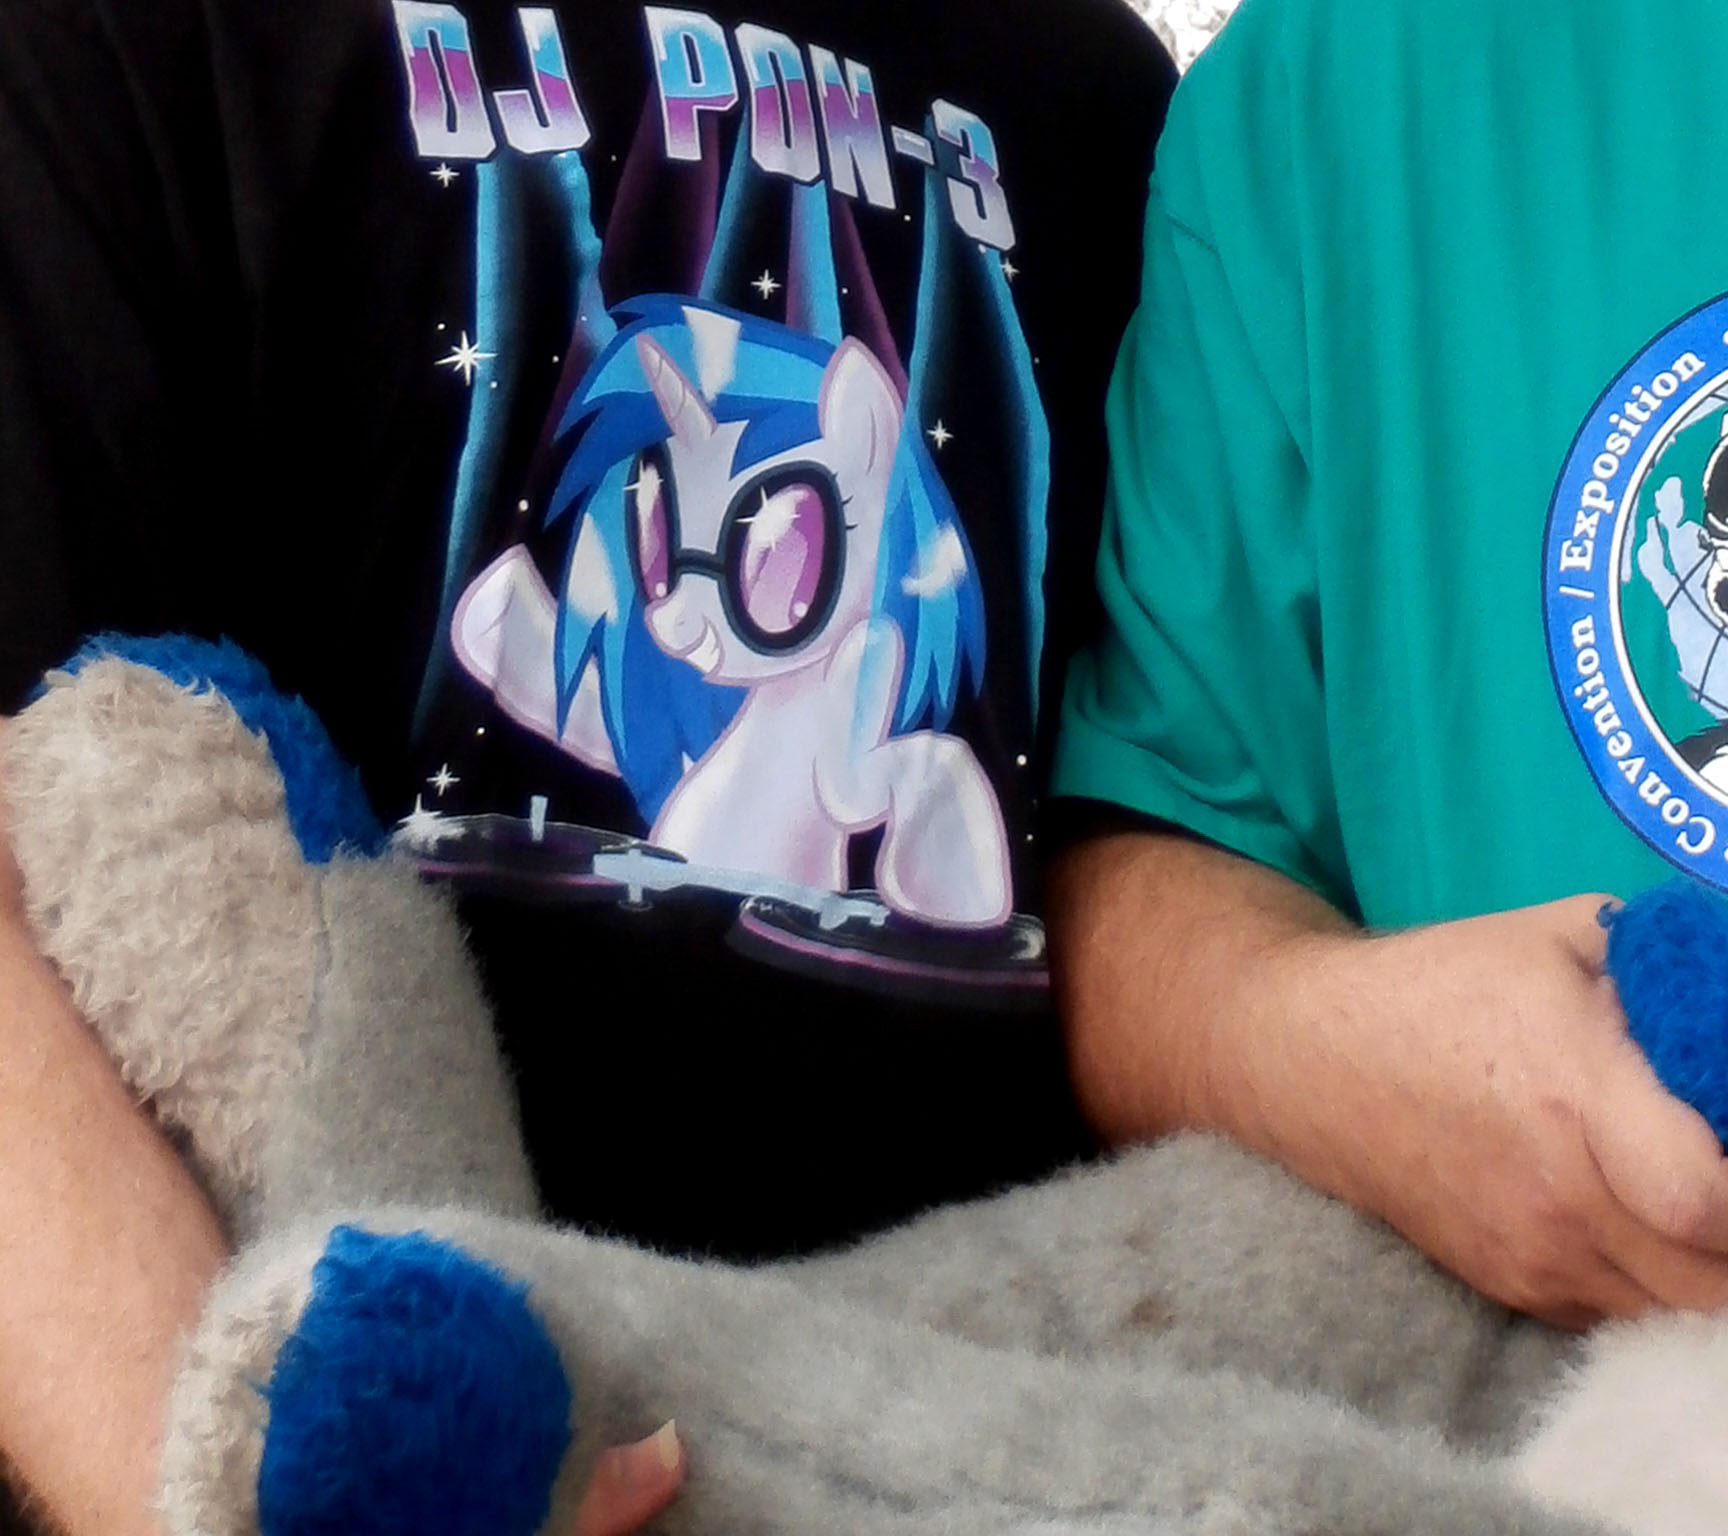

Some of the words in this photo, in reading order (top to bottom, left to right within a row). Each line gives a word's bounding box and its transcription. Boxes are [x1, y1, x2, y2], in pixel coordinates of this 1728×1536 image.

[643, 2, 1017, 253] PON-3
[1559, 350, 1706, 573] Exposition
[1573, 614, 1717, 855] Convention
